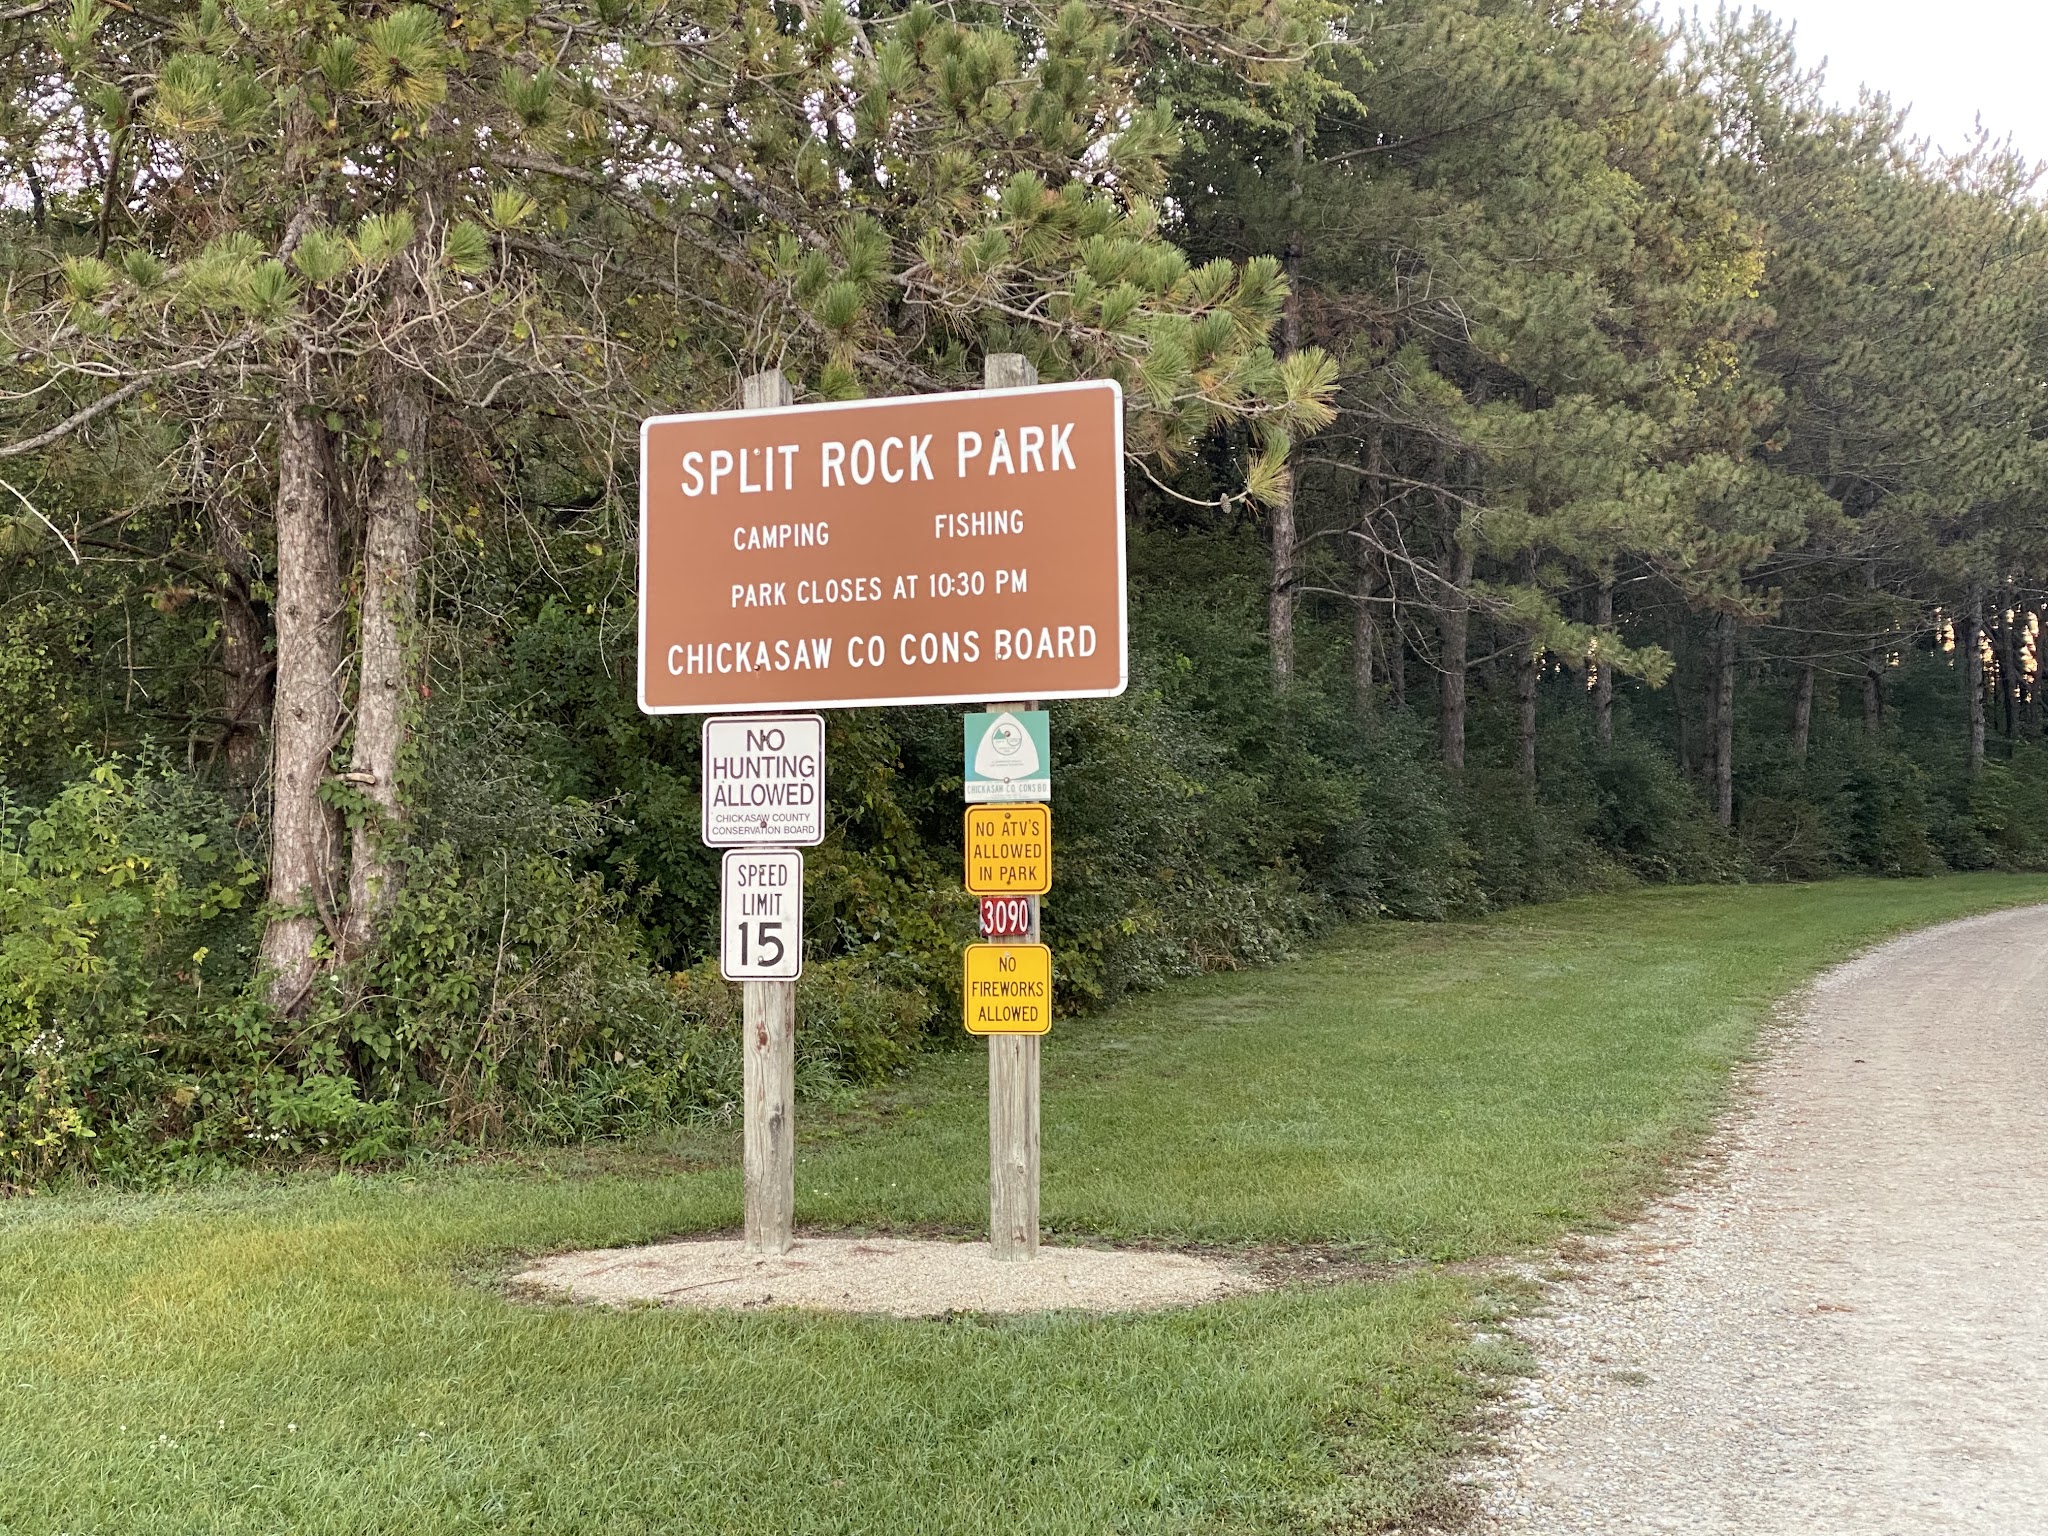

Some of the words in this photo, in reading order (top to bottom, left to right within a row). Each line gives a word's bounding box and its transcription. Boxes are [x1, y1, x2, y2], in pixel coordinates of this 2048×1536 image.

[681, 444, 800, 497] SPLIT
[822, 434, 935, 488] ROCK
[957, 422, 1077, 478] PARK
[733, 521, 829, 551] CAMPING
[935, 509, 1024, 539] FISHING
[731, 582, 787, 608] PARK
[797, 577, 882, 605] CLOSES
[893, 574, 919, 600] AT
[929, 570, 985, 598] 10:30
[995, 568, 1027, 595] PM
[667, 637, 833, 676] CHICKASAW
[847, 635, 886, 668] CO
[900, 630, 980, 666] CONS
[995, 624, 1097, 661] BOARD
[746, 728, 786, 752] NO
[713, 754, 815, 780] HUNTING
[713, 782, 815, 807] ALLOWED
[967, 784, 1004, 794] CHICKASAW
[712, 825, 781, 835] CONSERVATION
[783, 824, 815, 835] BOARD
[715, 813, 770, 824] CHICKASAW
[772, 813, 811, 822] COUNTY
[975, 821, 995, 837] NO
[1001, 818, 1040, 837] ATV'S
[973, 842, 1042, 859] ALLOWED
[737, 863, 788, 887] SPEED
[979, 865, 993, 881] IN
[999, 865, 1038, 882] PARK
[742, 893, 783, 916] LIMIT
[984, 899, 1029, 935] 3090
[738, 921, 785, 968] 15
[999, 956, 1017, 972] NO
[971, 980, 1045, 997] FIREWORKS
[977, 1005, 1039, 1022] ALLOWED
